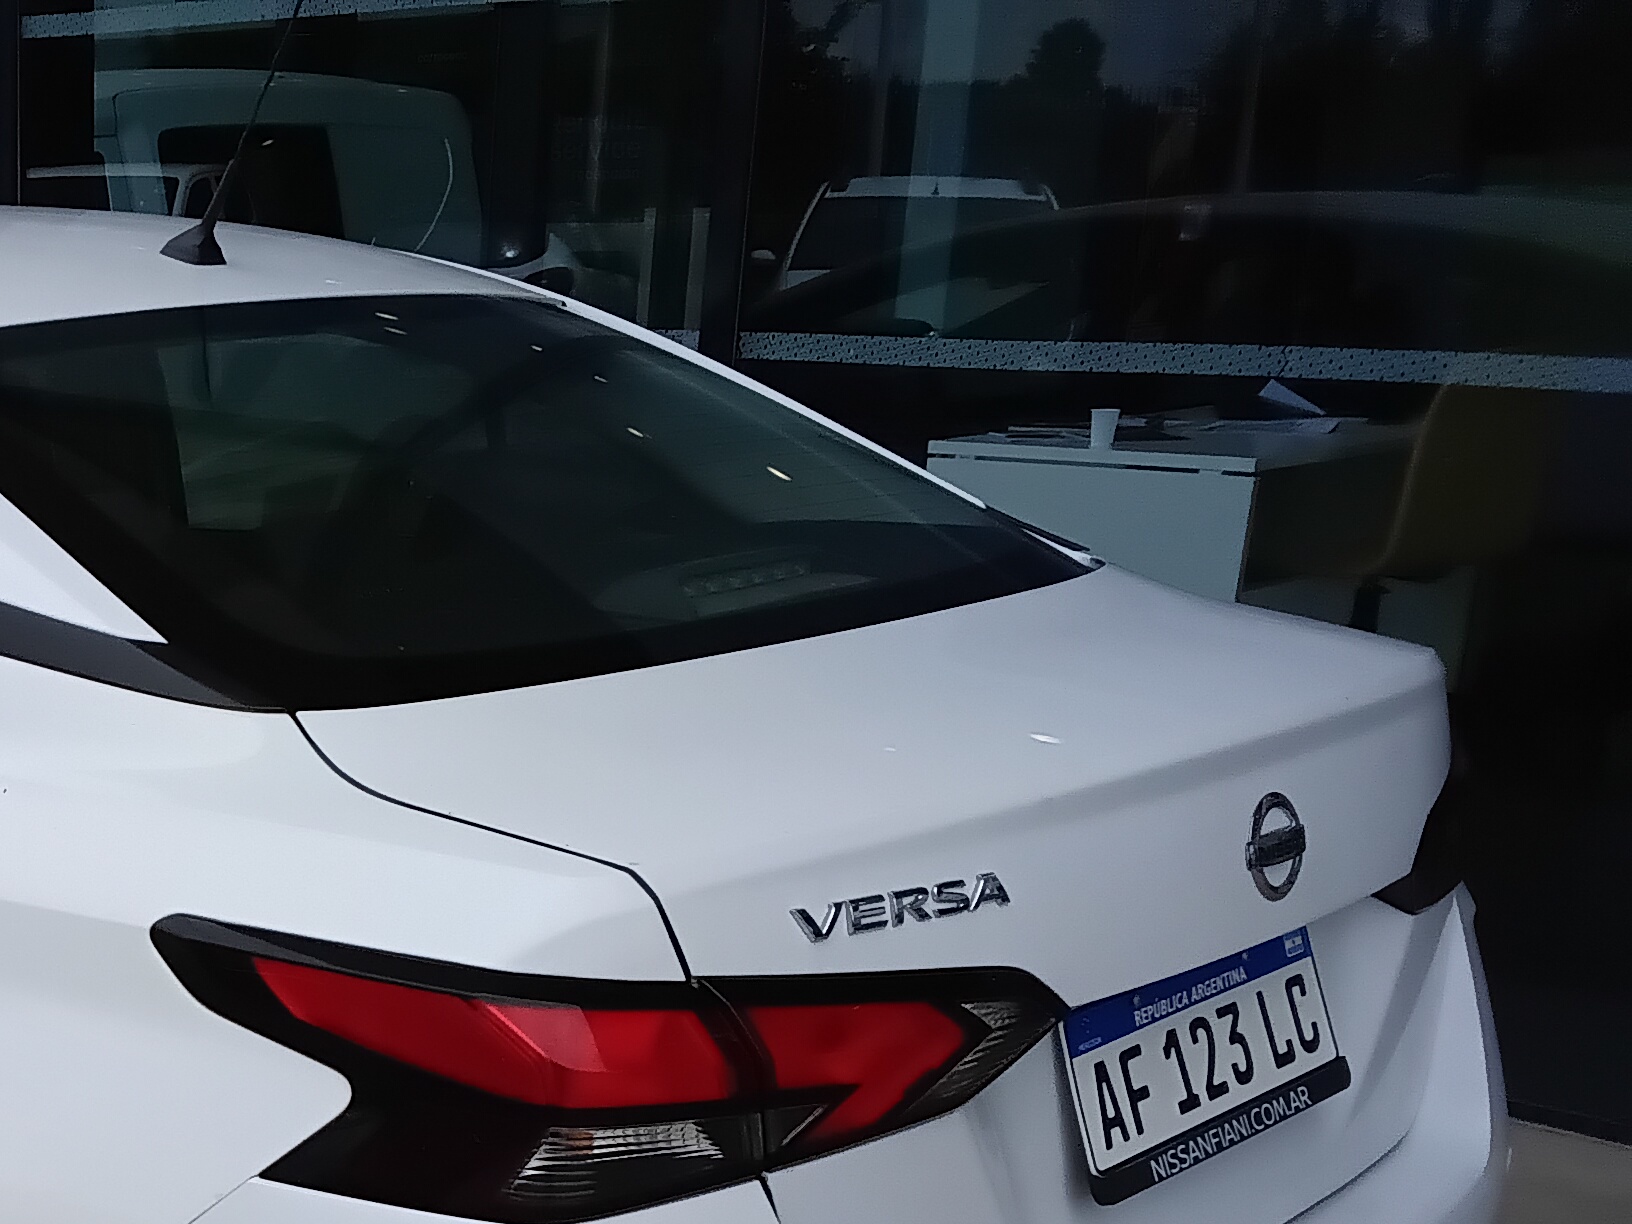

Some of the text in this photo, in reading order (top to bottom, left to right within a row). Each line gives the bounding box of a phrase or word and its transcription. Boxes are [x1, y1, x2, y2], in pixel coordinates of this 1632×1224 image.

[789, 871, 1011, 943] VERSA
[1133, 965, 1248, 1027] REPÚBLICA ARGENTINA
[1093, 973, 1321, 1151] AF 123 LC
[1150, 1085, 1313, 1183] NISSANFIANI.COM.AR
